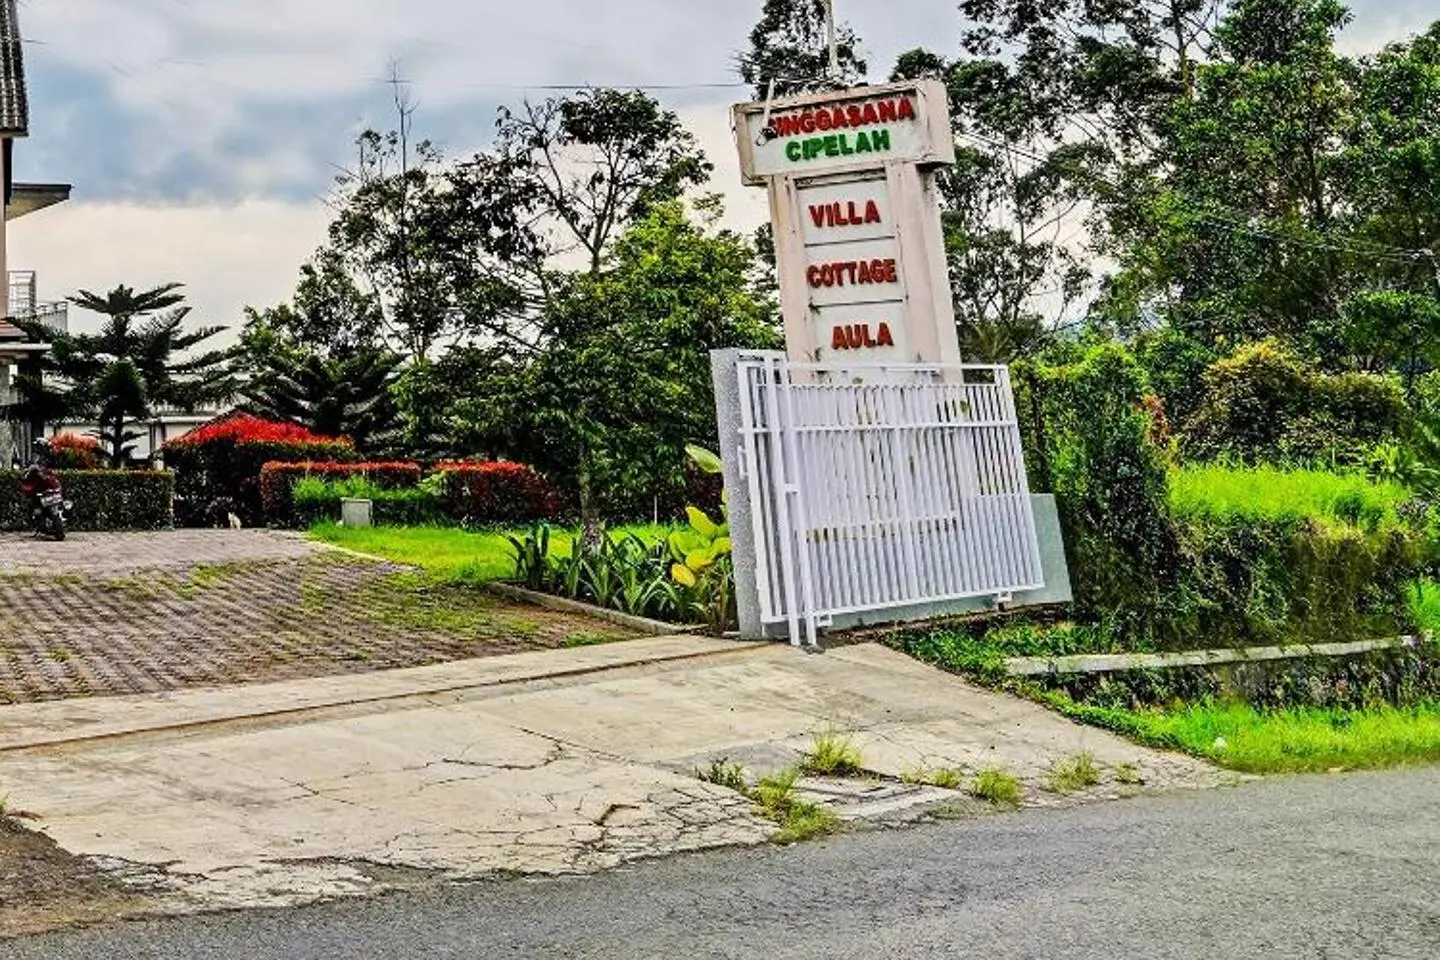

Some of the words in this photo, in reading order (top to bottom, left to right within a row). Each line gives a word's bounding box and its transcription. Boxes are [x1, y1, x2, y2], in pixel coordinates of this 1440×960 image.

[785, 129, 891, 162] CIPELAH
[809, 200, 881, 228] VILLA
[806, 258, 897, 289] COTTAGE
[830, 322, 895, 351] AULA
